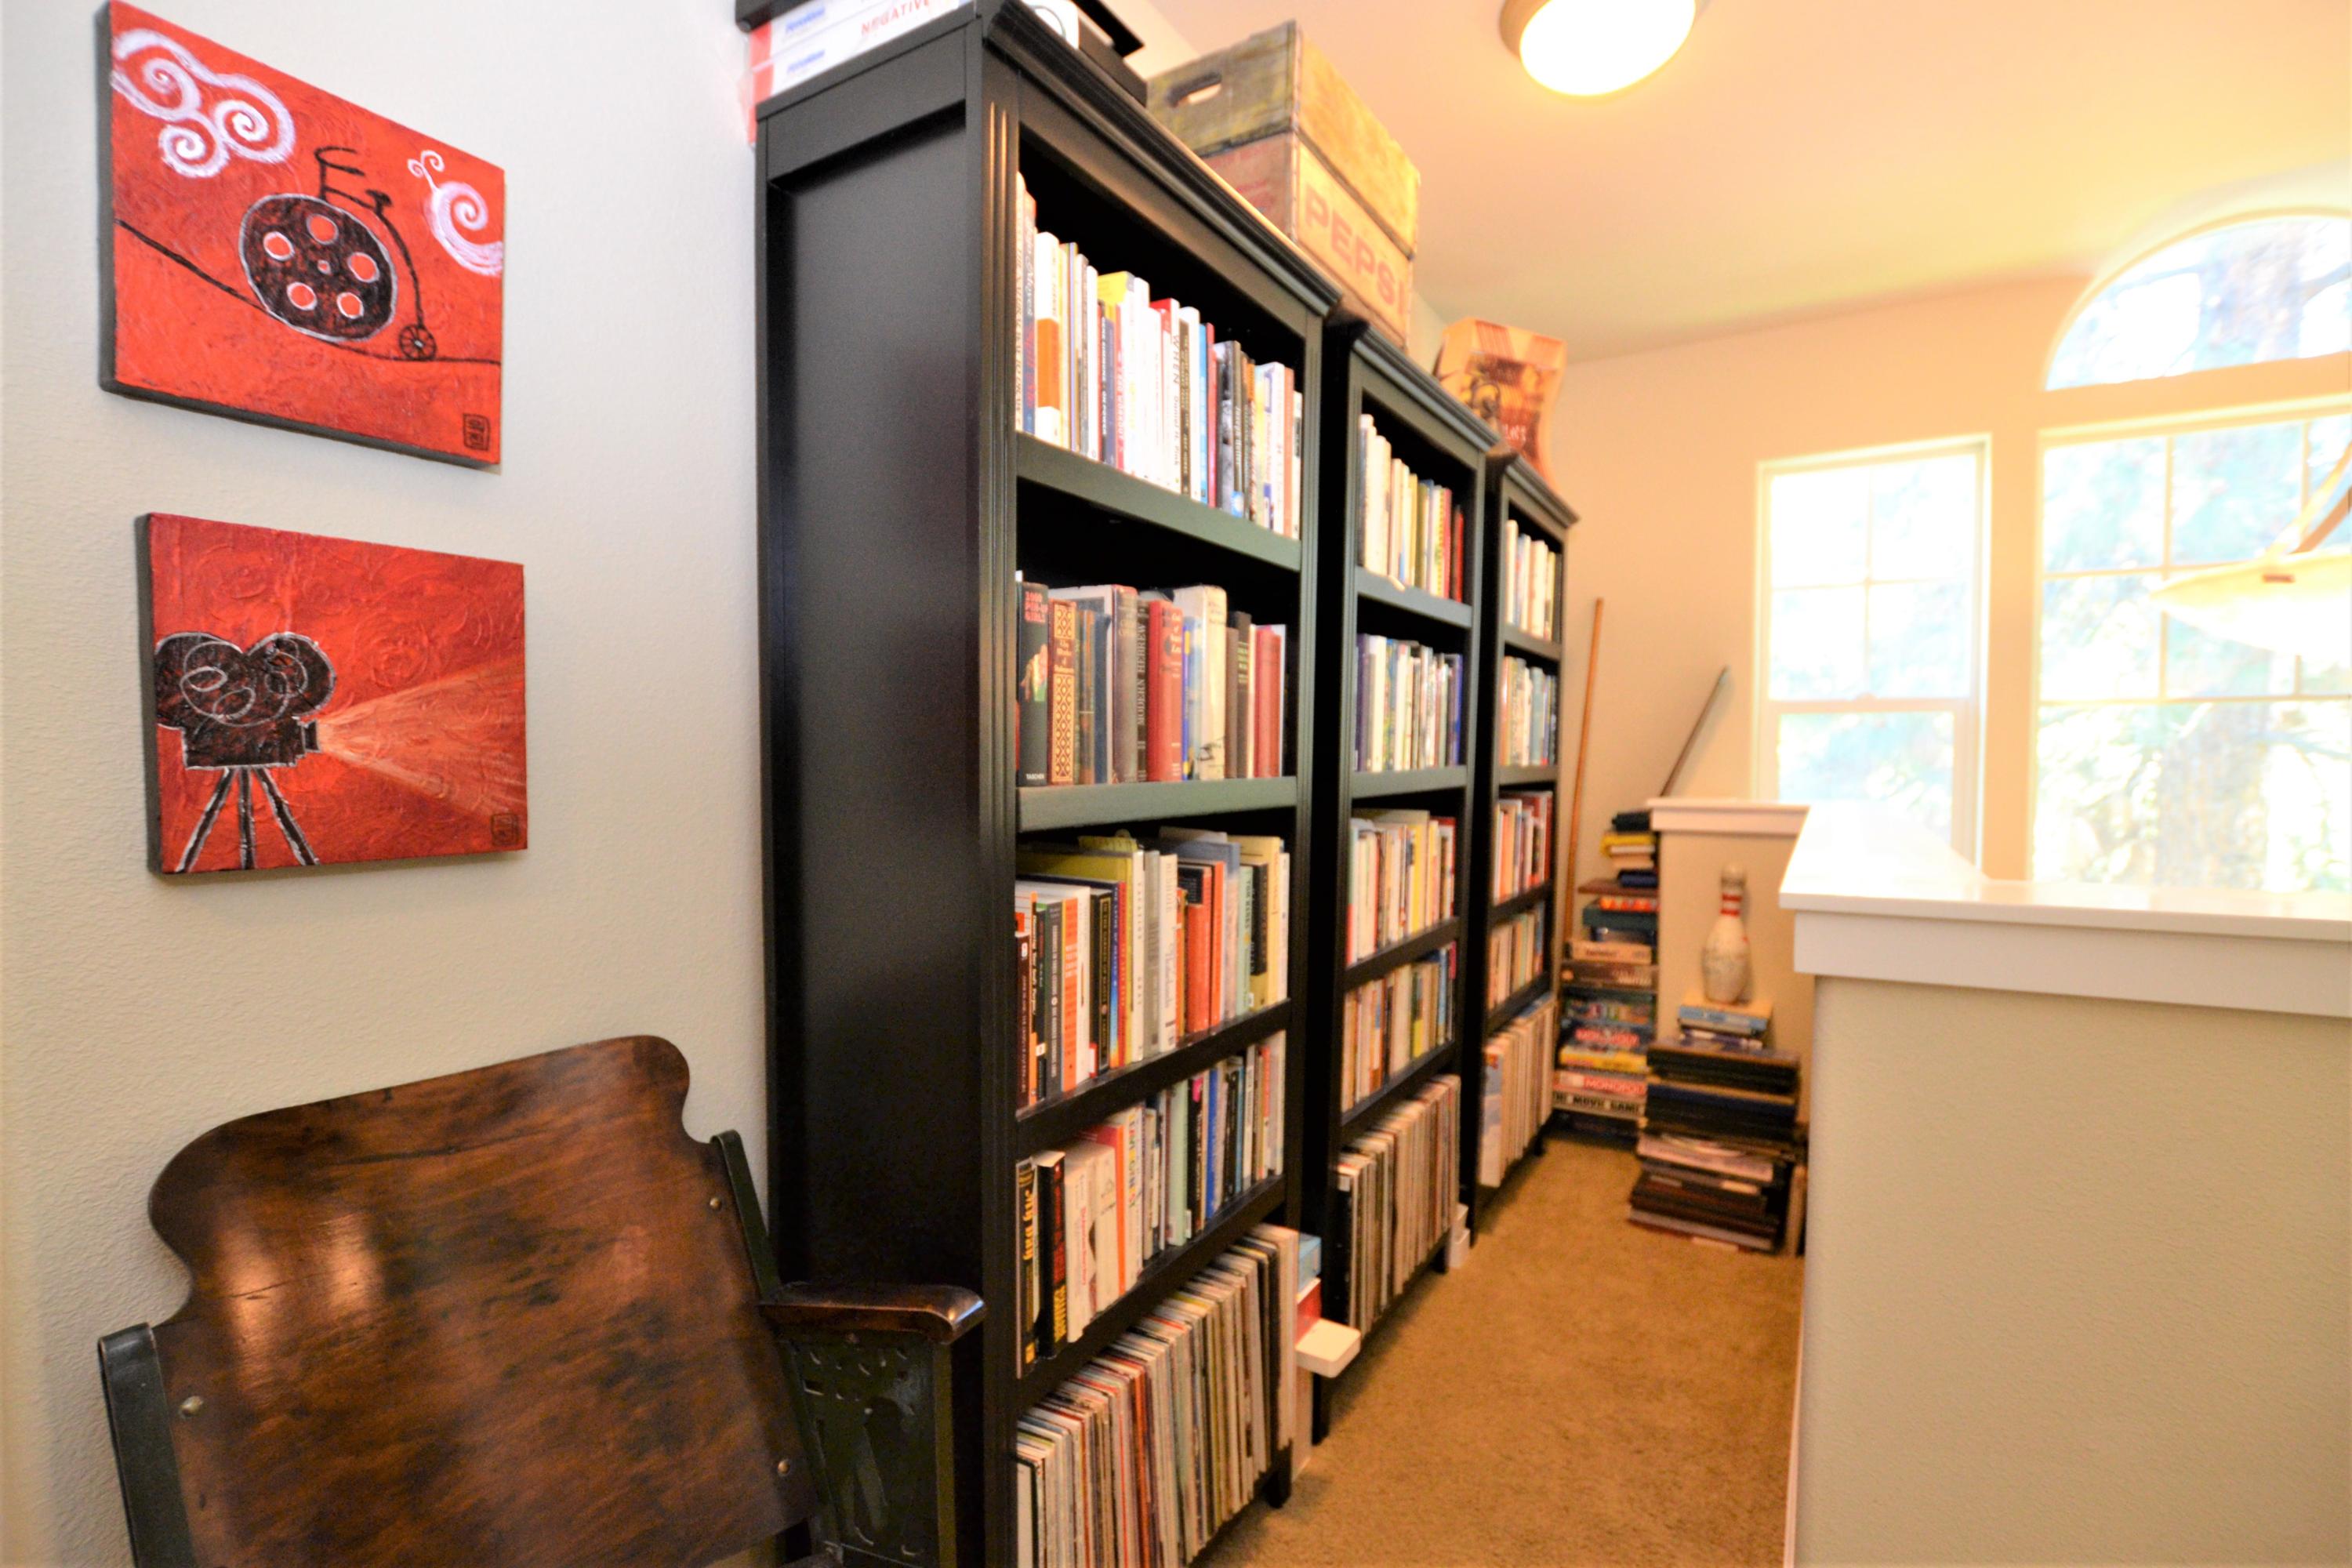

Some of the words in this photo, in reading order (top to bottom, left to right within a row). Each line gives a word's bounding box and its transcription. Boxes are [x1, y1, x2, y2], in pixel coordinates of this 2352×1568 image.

[1305, 184, 1406, 316] PEPSI
[1138, 623, 1146, 673] HEBREW
[1138, 678, 1146, 726] MODERN
